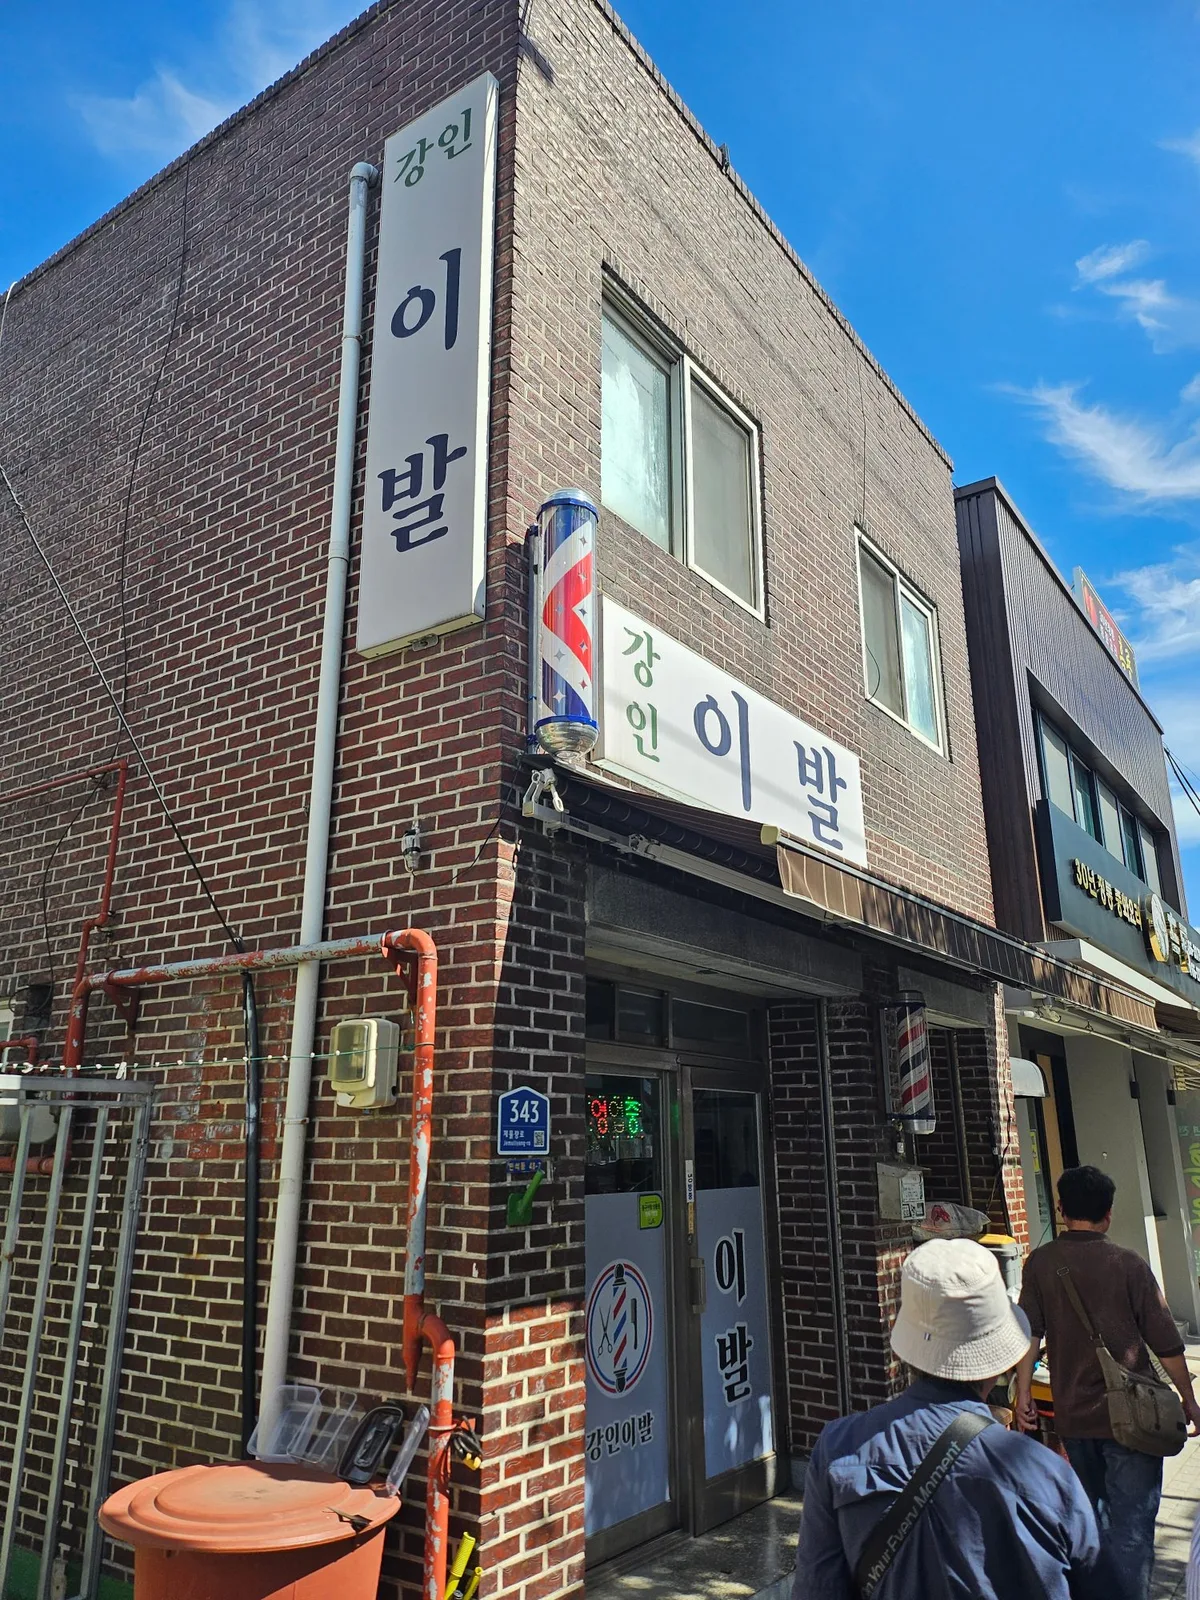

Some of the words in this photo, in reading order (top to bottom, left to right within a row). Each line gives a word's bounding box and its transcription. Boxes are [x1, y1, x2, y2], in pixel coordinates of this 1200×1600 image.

[395, 107, 472, 188] 강인
[622, 626, 660, 762] 강인
[1075, 858, 1097, 898] 30년
[509, 1099, 539, 1123] 343
[591, 1099, 639, 1134] 영업중
[586, 1409, 654, 1461] 강인이발
[914, 1440, 962, 1508] Moment
